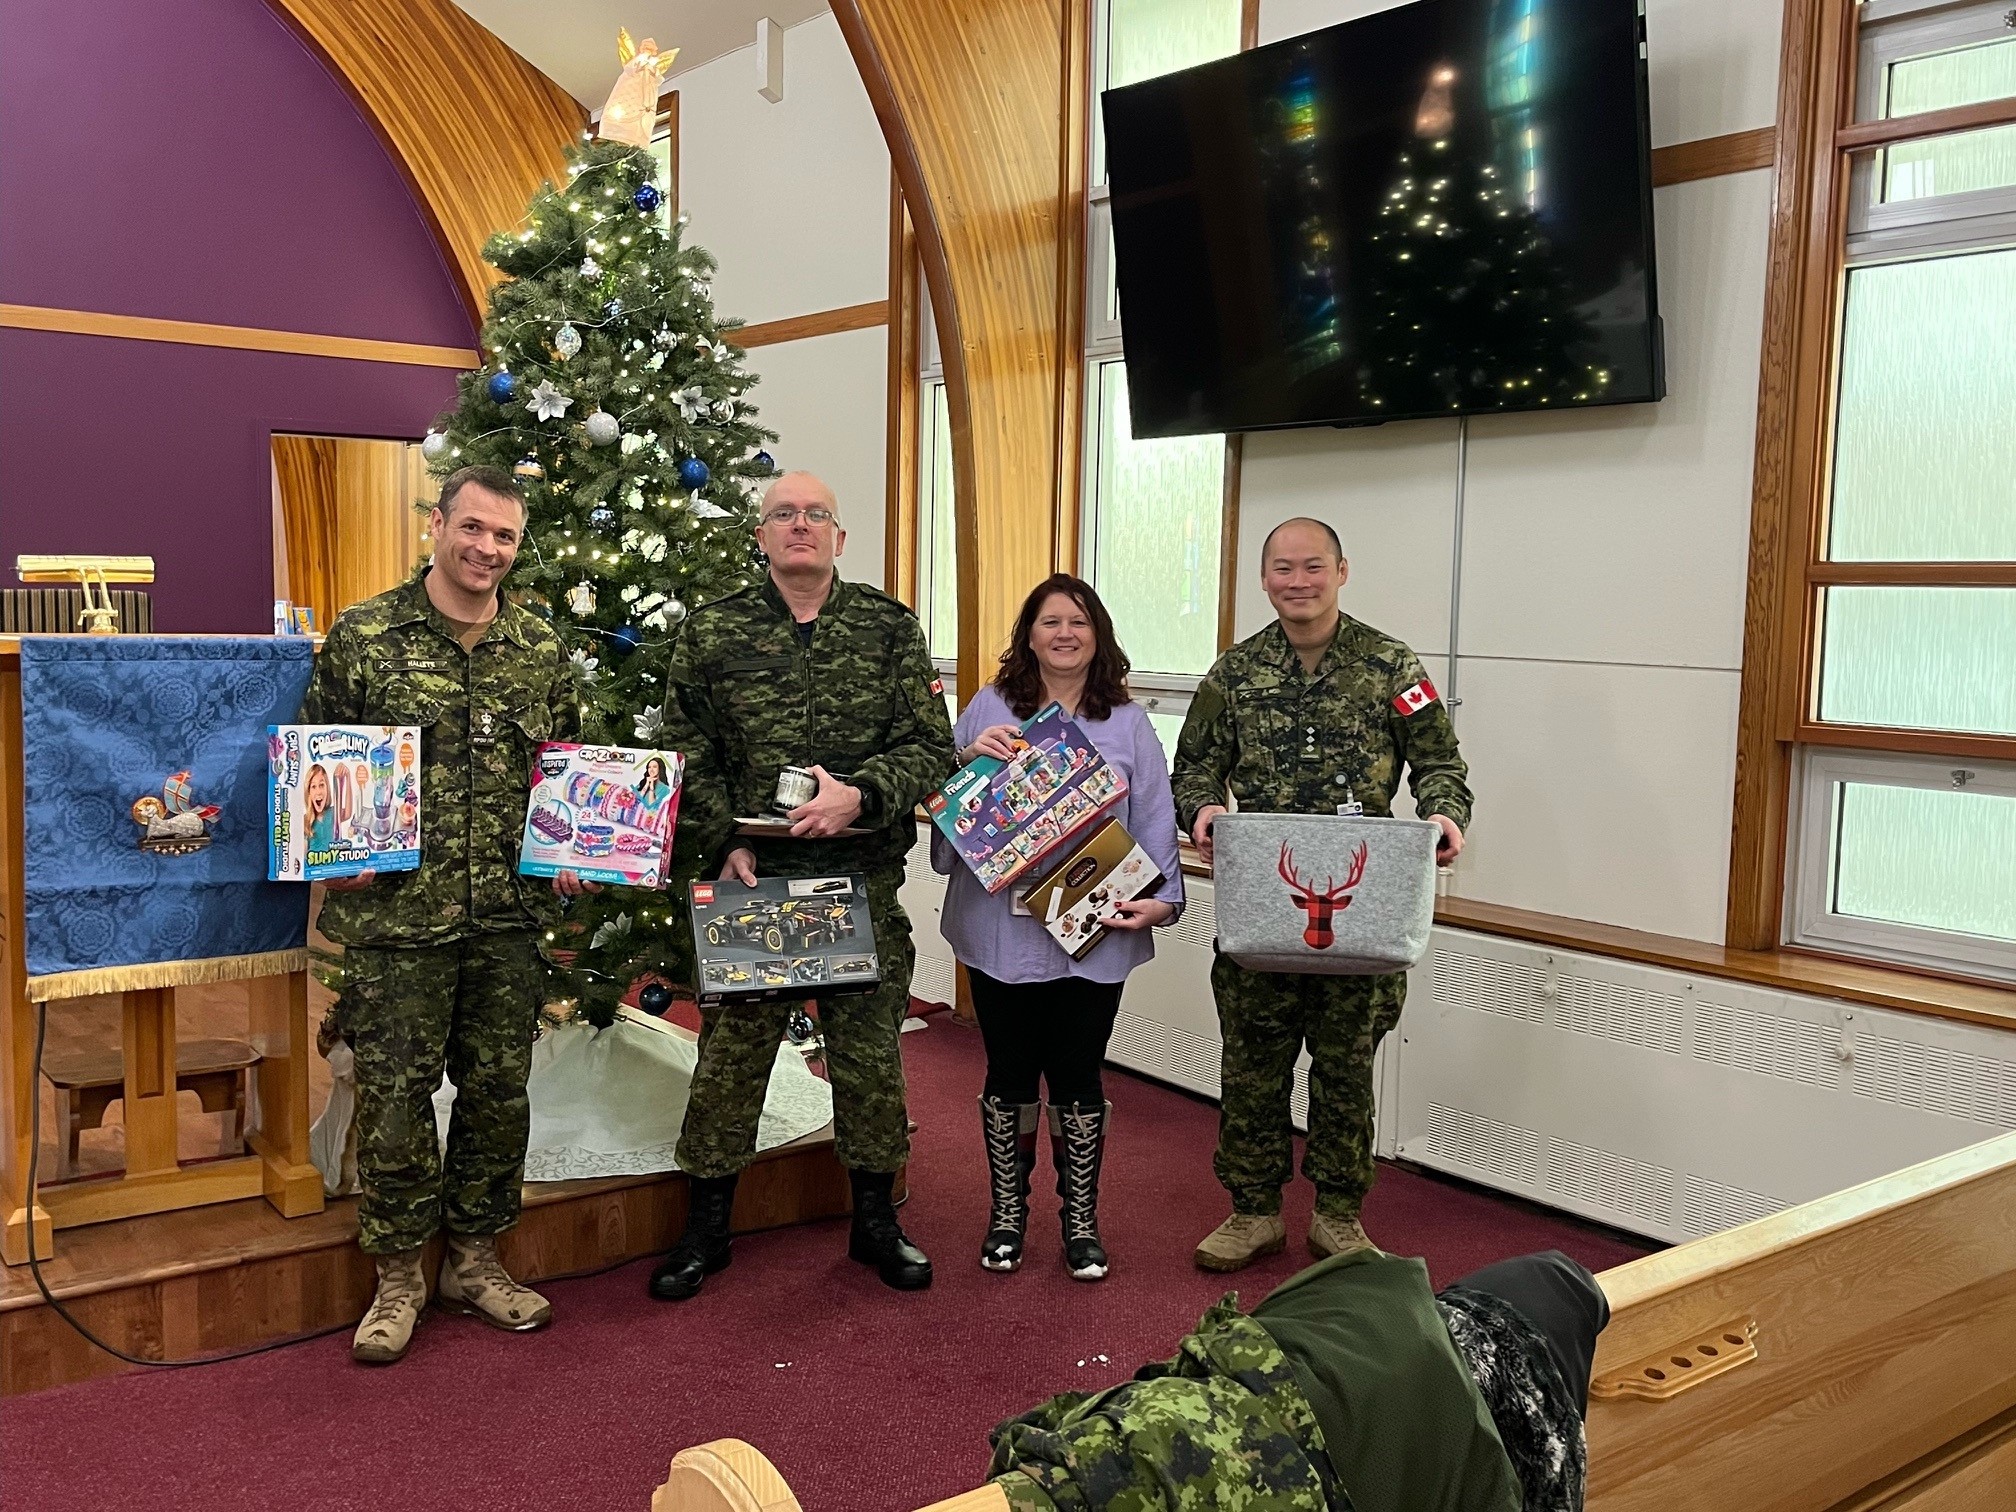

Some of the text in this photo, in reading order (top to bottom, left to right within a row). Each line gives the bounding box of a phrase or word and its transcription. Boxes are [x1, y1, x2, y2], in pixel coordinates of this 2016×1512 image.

[944, 769, 976, 796] Friends
[929, 795, 944, 808] LEGO
[581, 811, 591, 819] 24
[307, 850, 339, 866] SLIMY
[339, 850, 370, 862] STUDIO
[694, 889, 713, 898] LEGO
